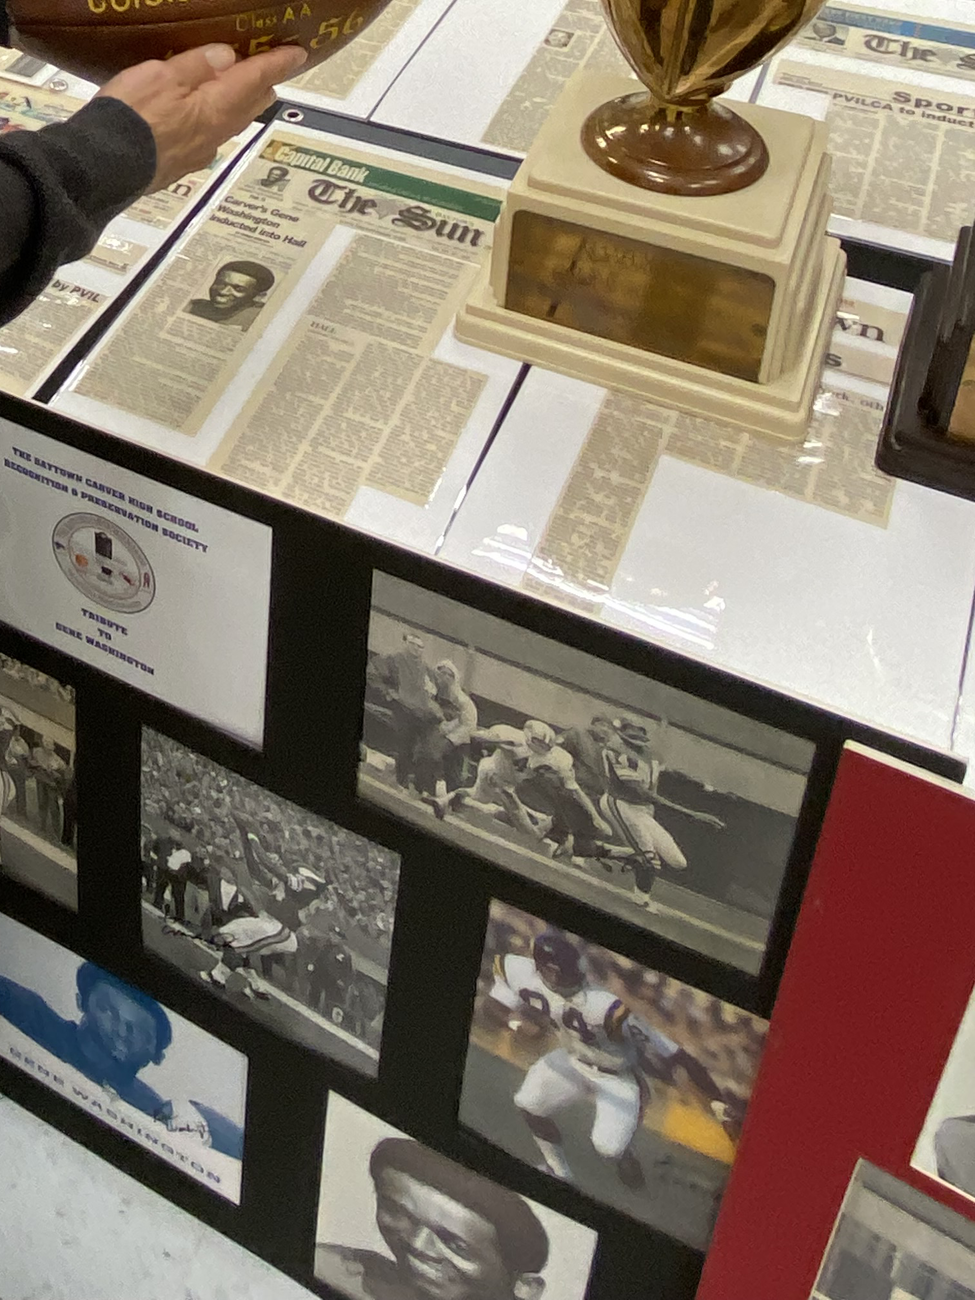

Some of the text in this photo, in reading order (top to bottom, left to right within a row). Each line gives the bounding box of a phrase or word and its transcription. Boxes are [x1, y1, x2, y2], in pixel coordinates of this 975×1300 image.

[862, 34, 937, 62] The
[832, 92, 893, 112] PVILCA
[899, 106, 916, 116] to
[892, 91, 975, 118] Spor
[277, 146, 370, 183] Capital Bank
[216, 204, 281, 229] Washington
[224, 195, 268, 214] Carver's
[270, 208, 300, 223] Gene
[307, 178, 378, 216] The
[391, 205, 485, 248] Sun
[208, 213, 259, 234] Inducted
[259, 228, 281, 241] into
[282, 235, 308, 248] Hall
[51, 279, 69, 292] by
[11, 446, 200, 534] THE BAYTOWN CARVER HIGH SCHOOL
[3, 457, 69, 494] RECOGNITION
[80, 491, 159, 533] PRESERVATION
[161, 527, 209, 554] SOCIETY
[80, 607, 129, 637] TRIBUTE
[97, 627, 112, 642] TO
[55, 621, 155, 676] GENE WASHINGTON
[71, 1086, 222, 1185] WASHINGTON
